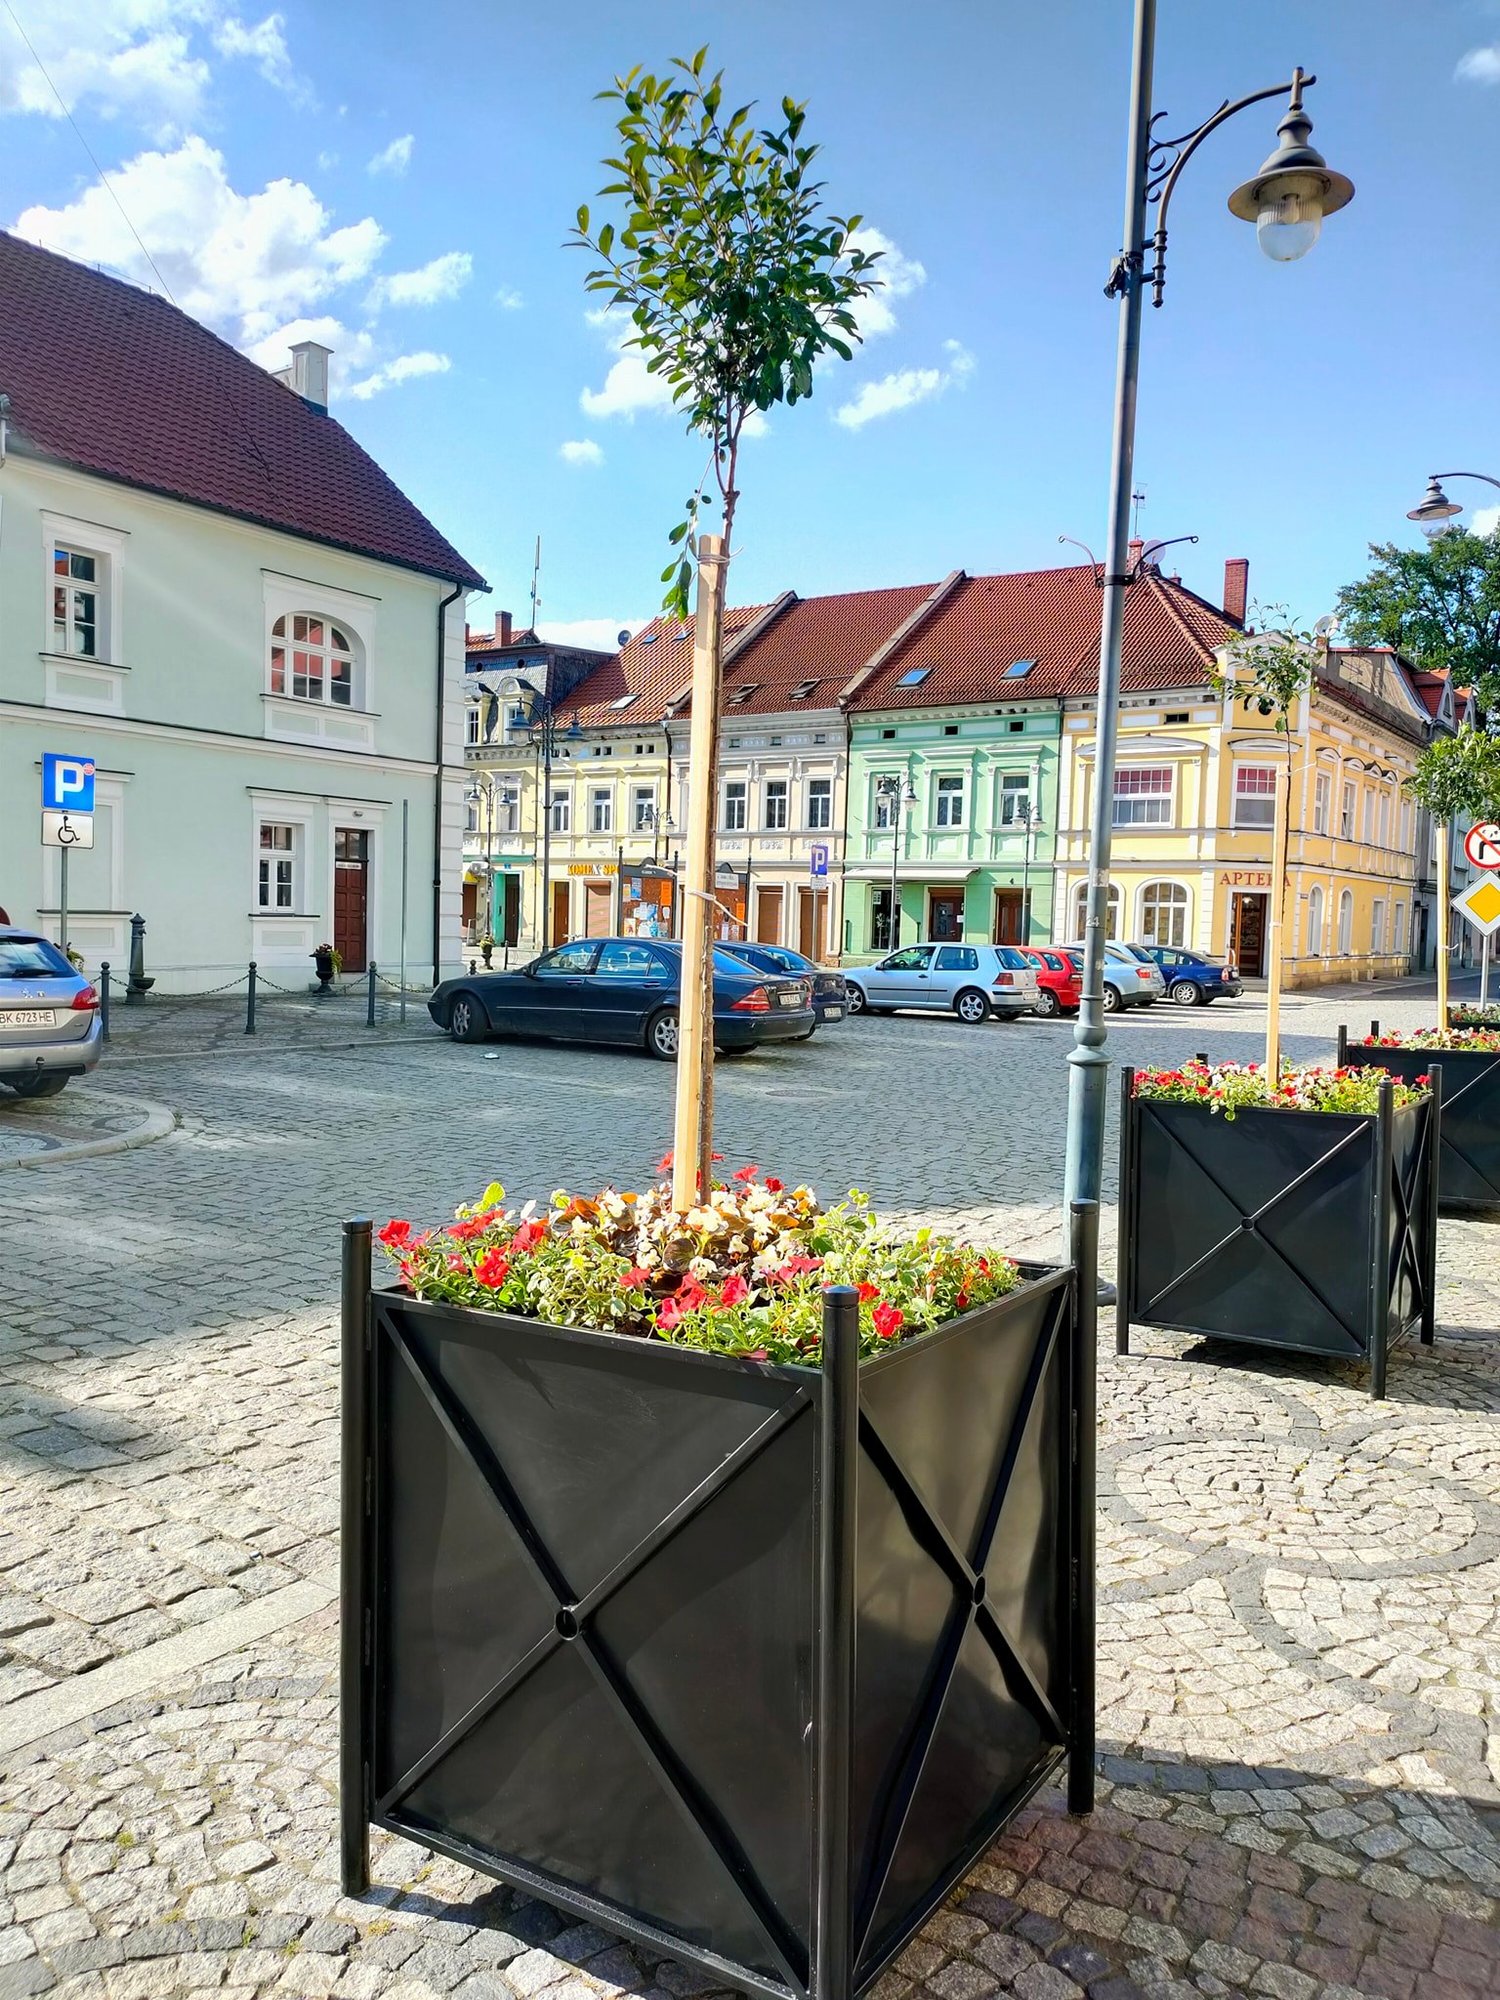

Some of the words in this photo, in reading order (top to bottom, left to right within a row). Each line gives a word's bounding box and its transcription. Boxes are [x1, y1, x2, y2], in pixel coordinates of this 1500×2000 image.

[55, 760, 84, 804] P
[815, 848, 825, 871] P
[567, 863, 602, 876] KOMEX
[16, 1012, 38, 1023] 6723
[39, 1012, 53, 1023] HE
